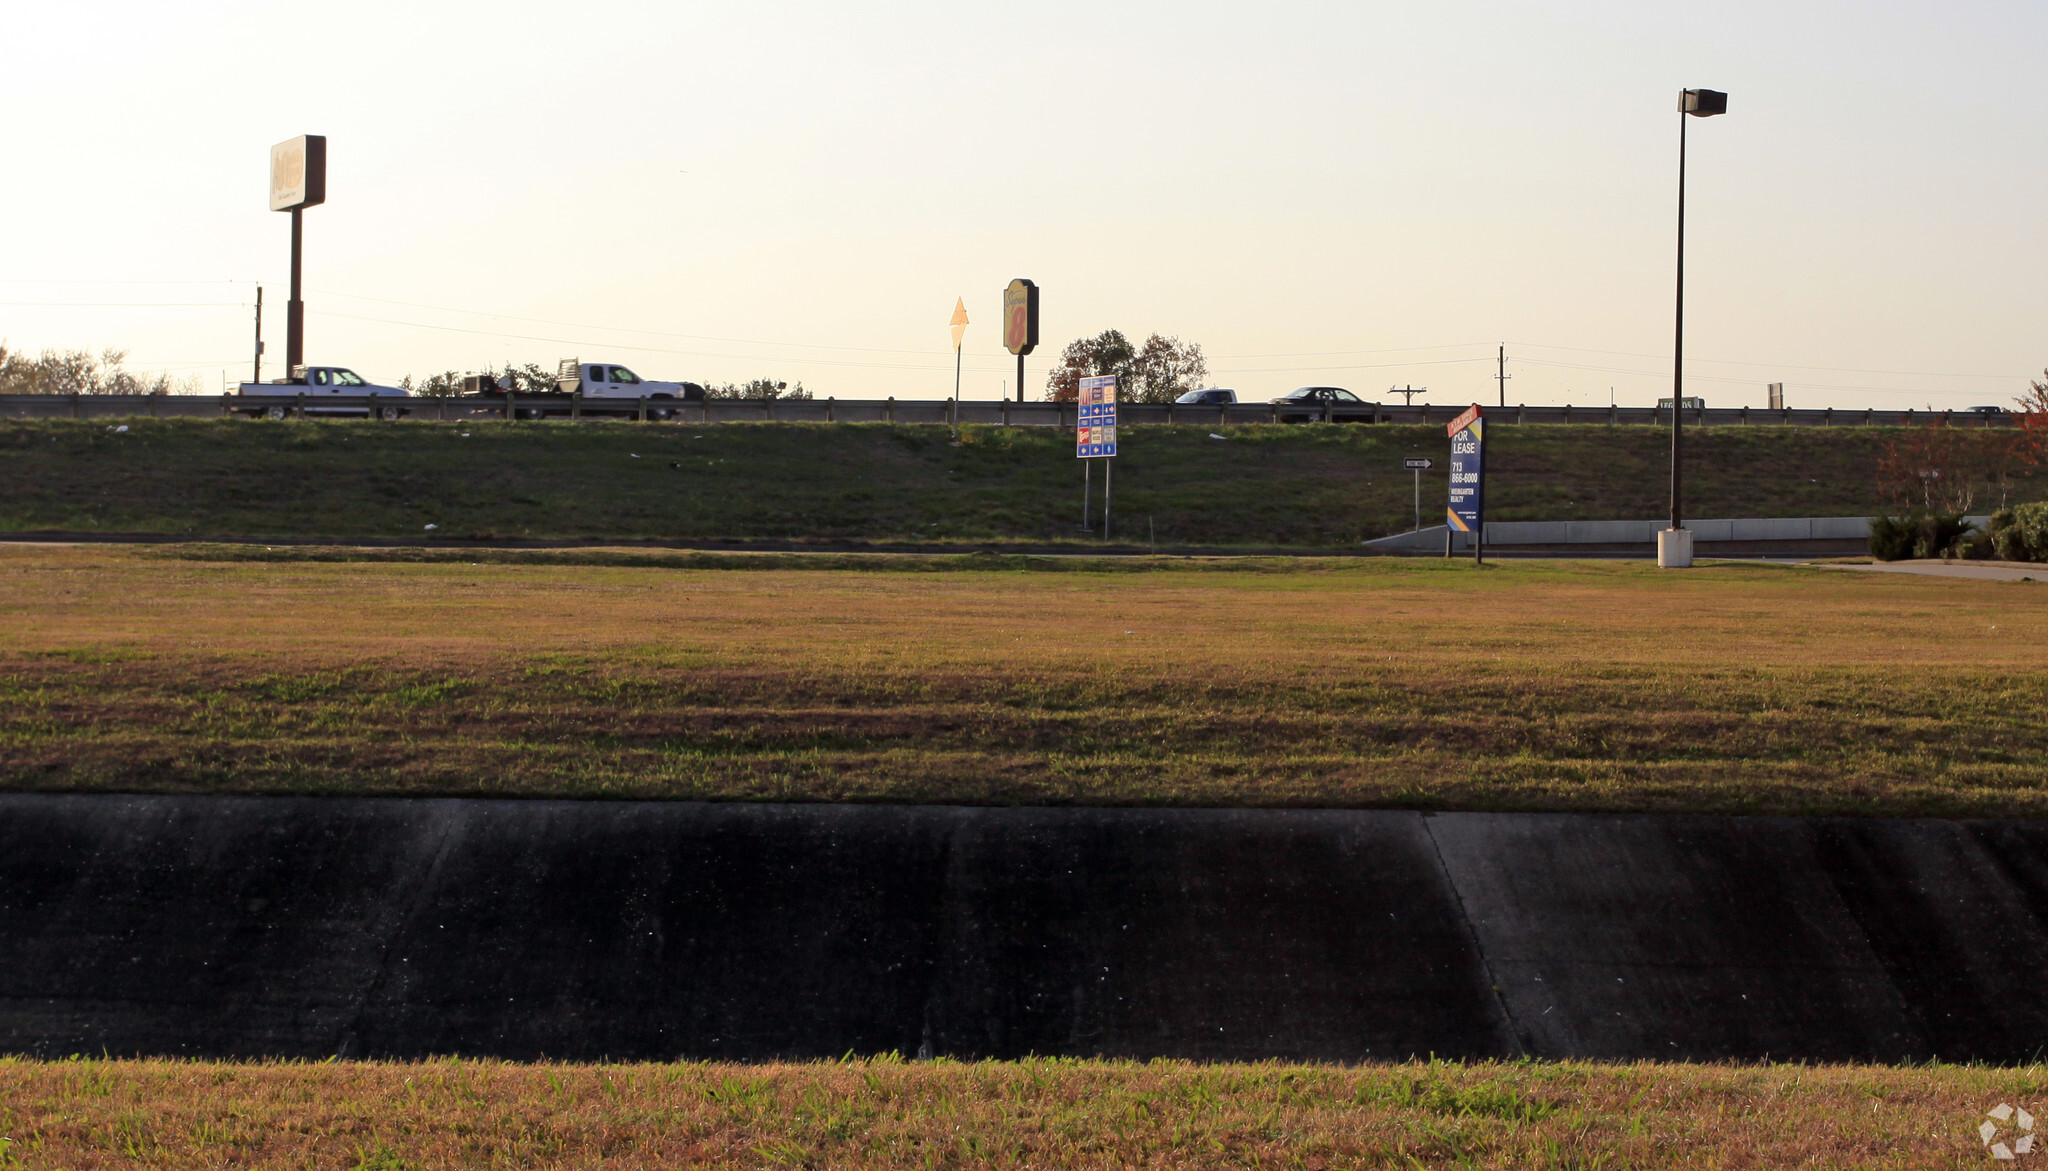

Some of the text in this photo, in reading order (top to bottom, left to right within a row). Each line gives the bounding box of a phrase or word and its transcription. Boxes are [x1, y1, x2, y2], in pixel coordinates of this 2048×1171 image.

[1009, 306, 1025, 347] 8
[1453, 443, 1475, 454] LEASE
[1452, 462, 1462, 471] 713
